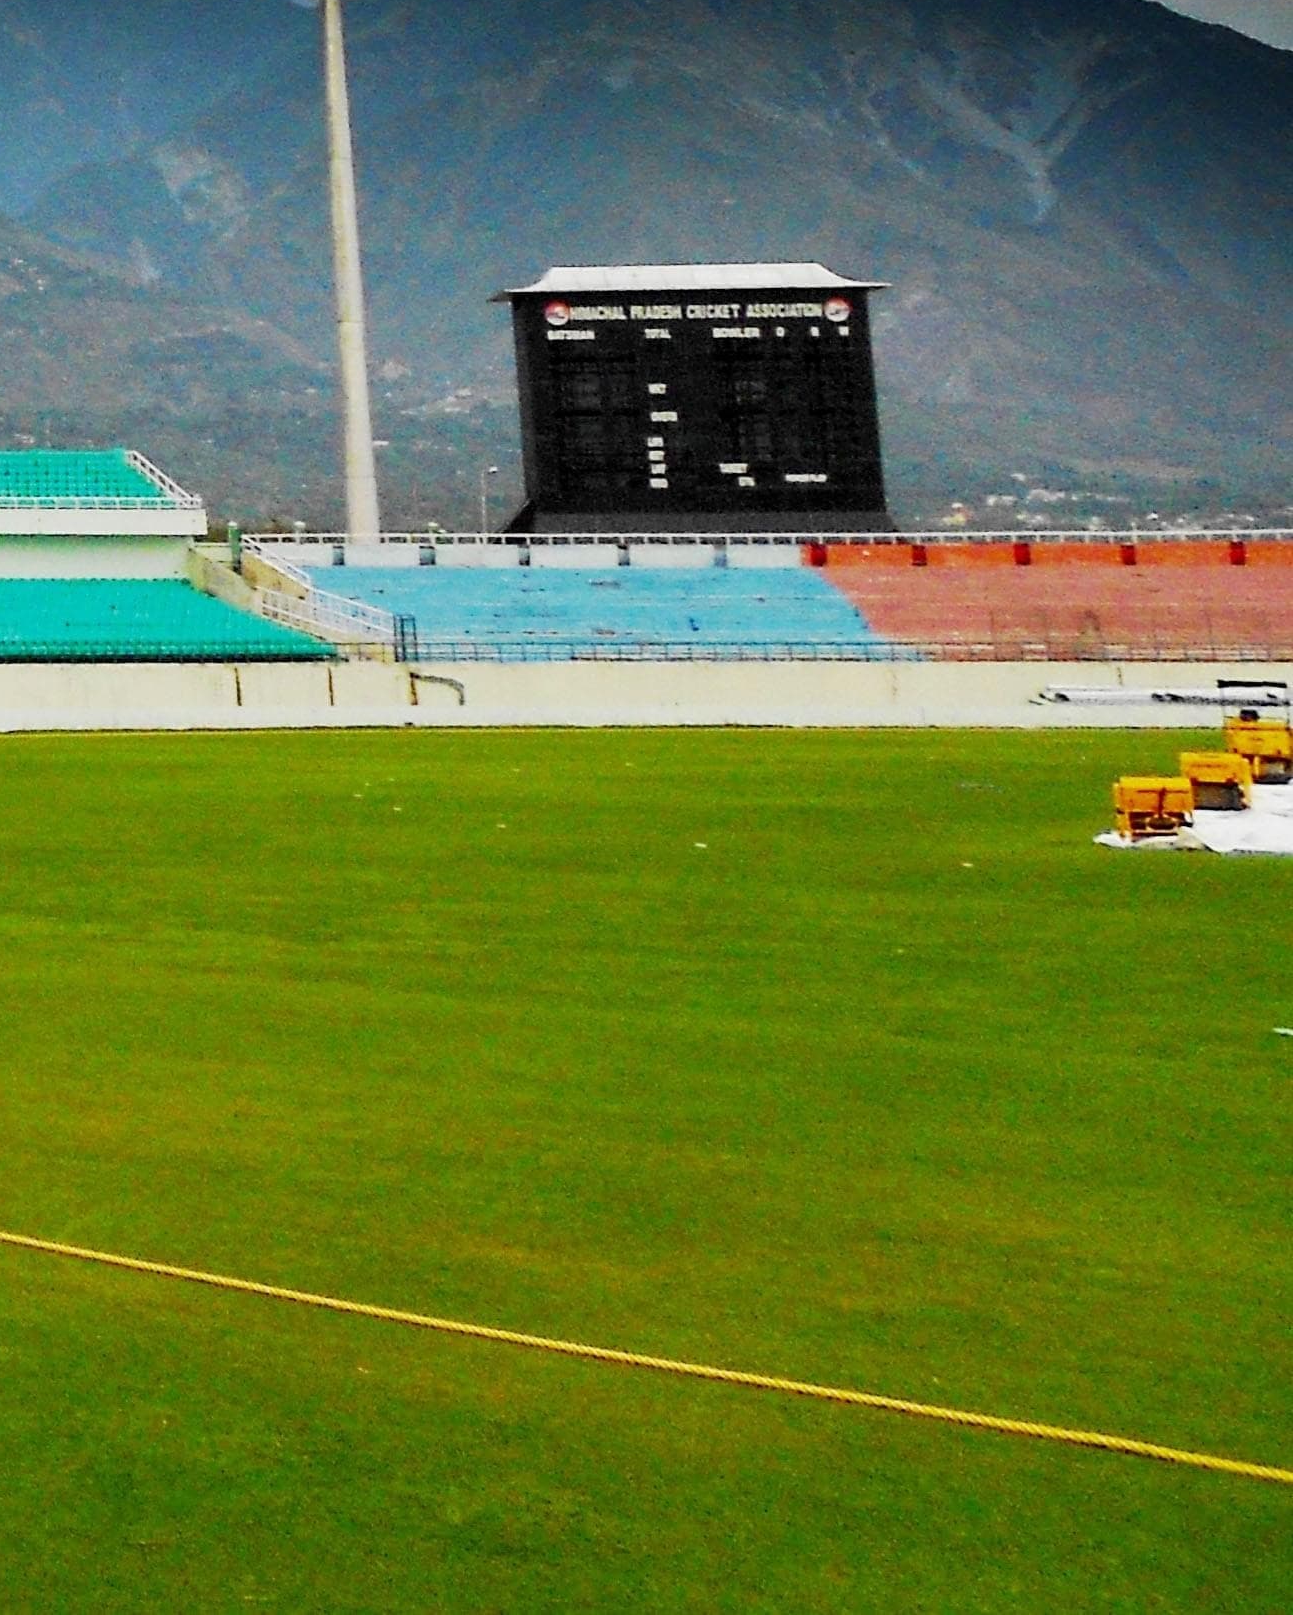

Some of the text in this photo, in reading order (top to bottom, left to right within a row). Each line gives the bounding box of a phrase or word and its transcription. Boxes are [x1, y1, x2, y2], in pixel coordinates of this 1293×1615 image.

[630, 305, 683, 319] PRADESH
[686, 304, 741, 319] CRICKET
[746, 303, 823, 318] ASSOCIATION
